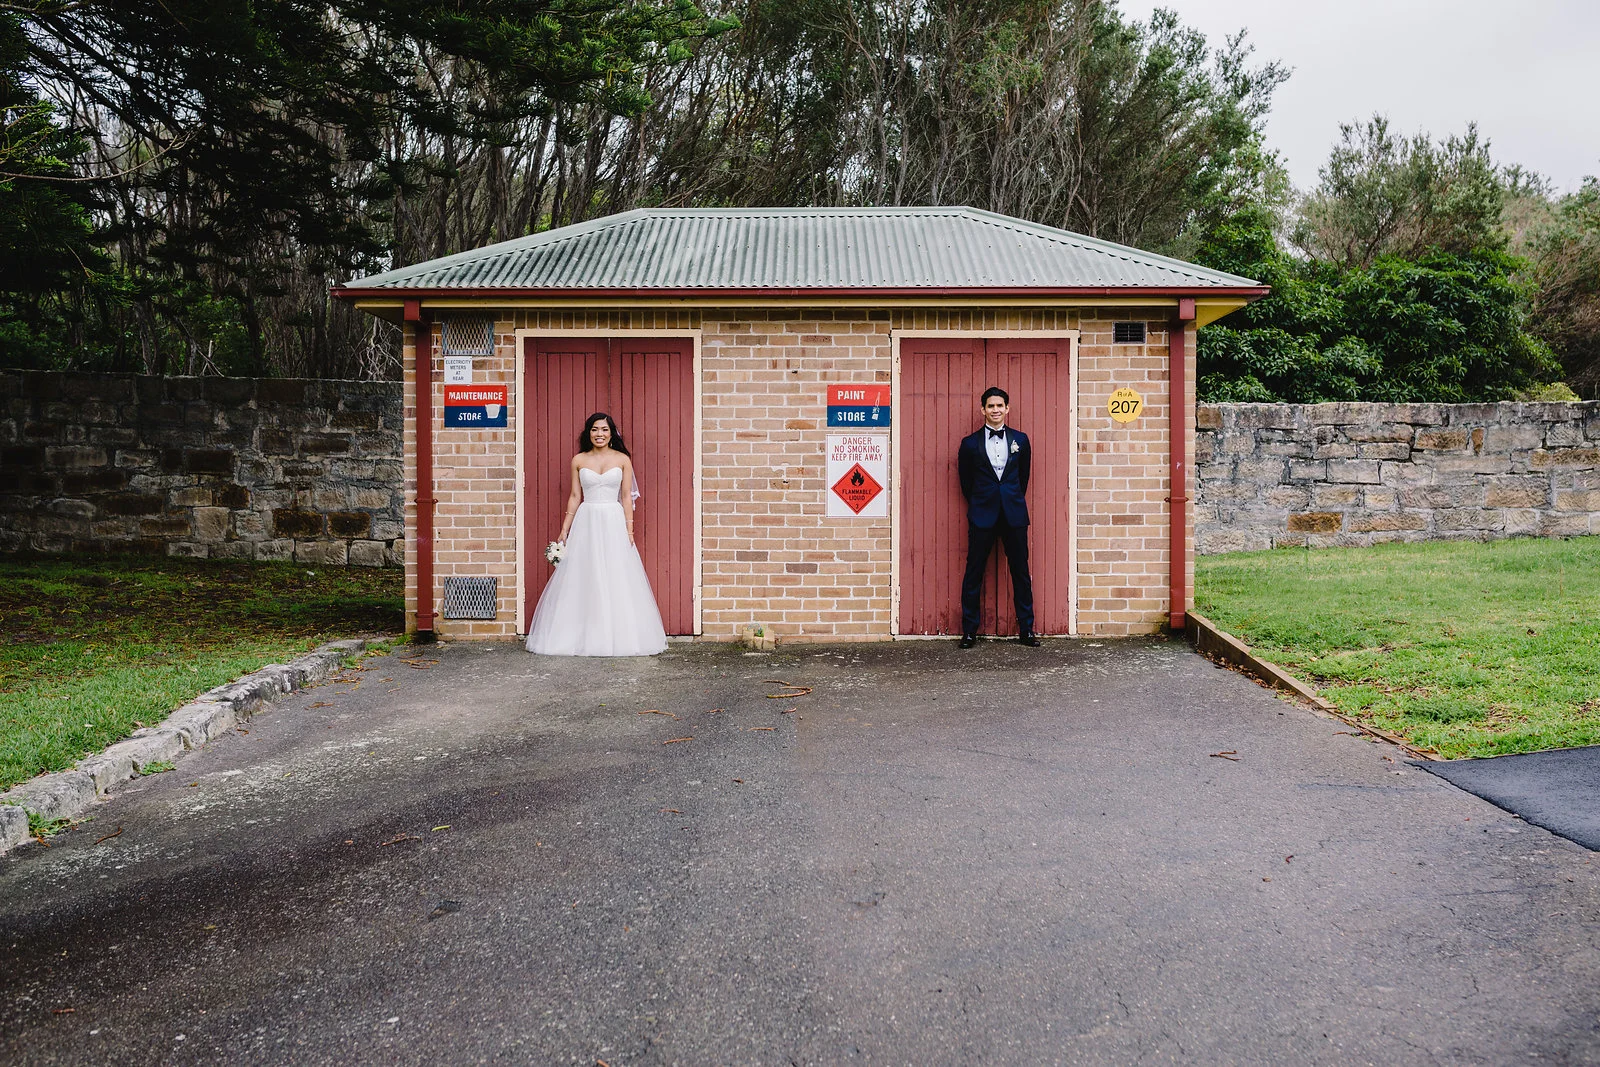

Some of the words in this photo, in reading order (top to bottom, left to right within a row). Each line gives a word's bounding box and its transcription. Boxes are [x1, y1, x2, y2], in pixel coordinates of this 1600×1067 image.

[448, 391, 504, 401] MAINTENANCE
[837, 390, 866, 400] PAINT
[1111, 400, 1140, 414] 207
[458, 412, 482, 421] STORE
[842, 436, 872, 444] DANGER
[834, 445, 844, 453] NO
[847, 445, 880, 453] SMOKING
[831, 453, 848, 462] KEEP
[848, 453, 862, 462] FIRE
[864, 453, 883, 462] AWAY
